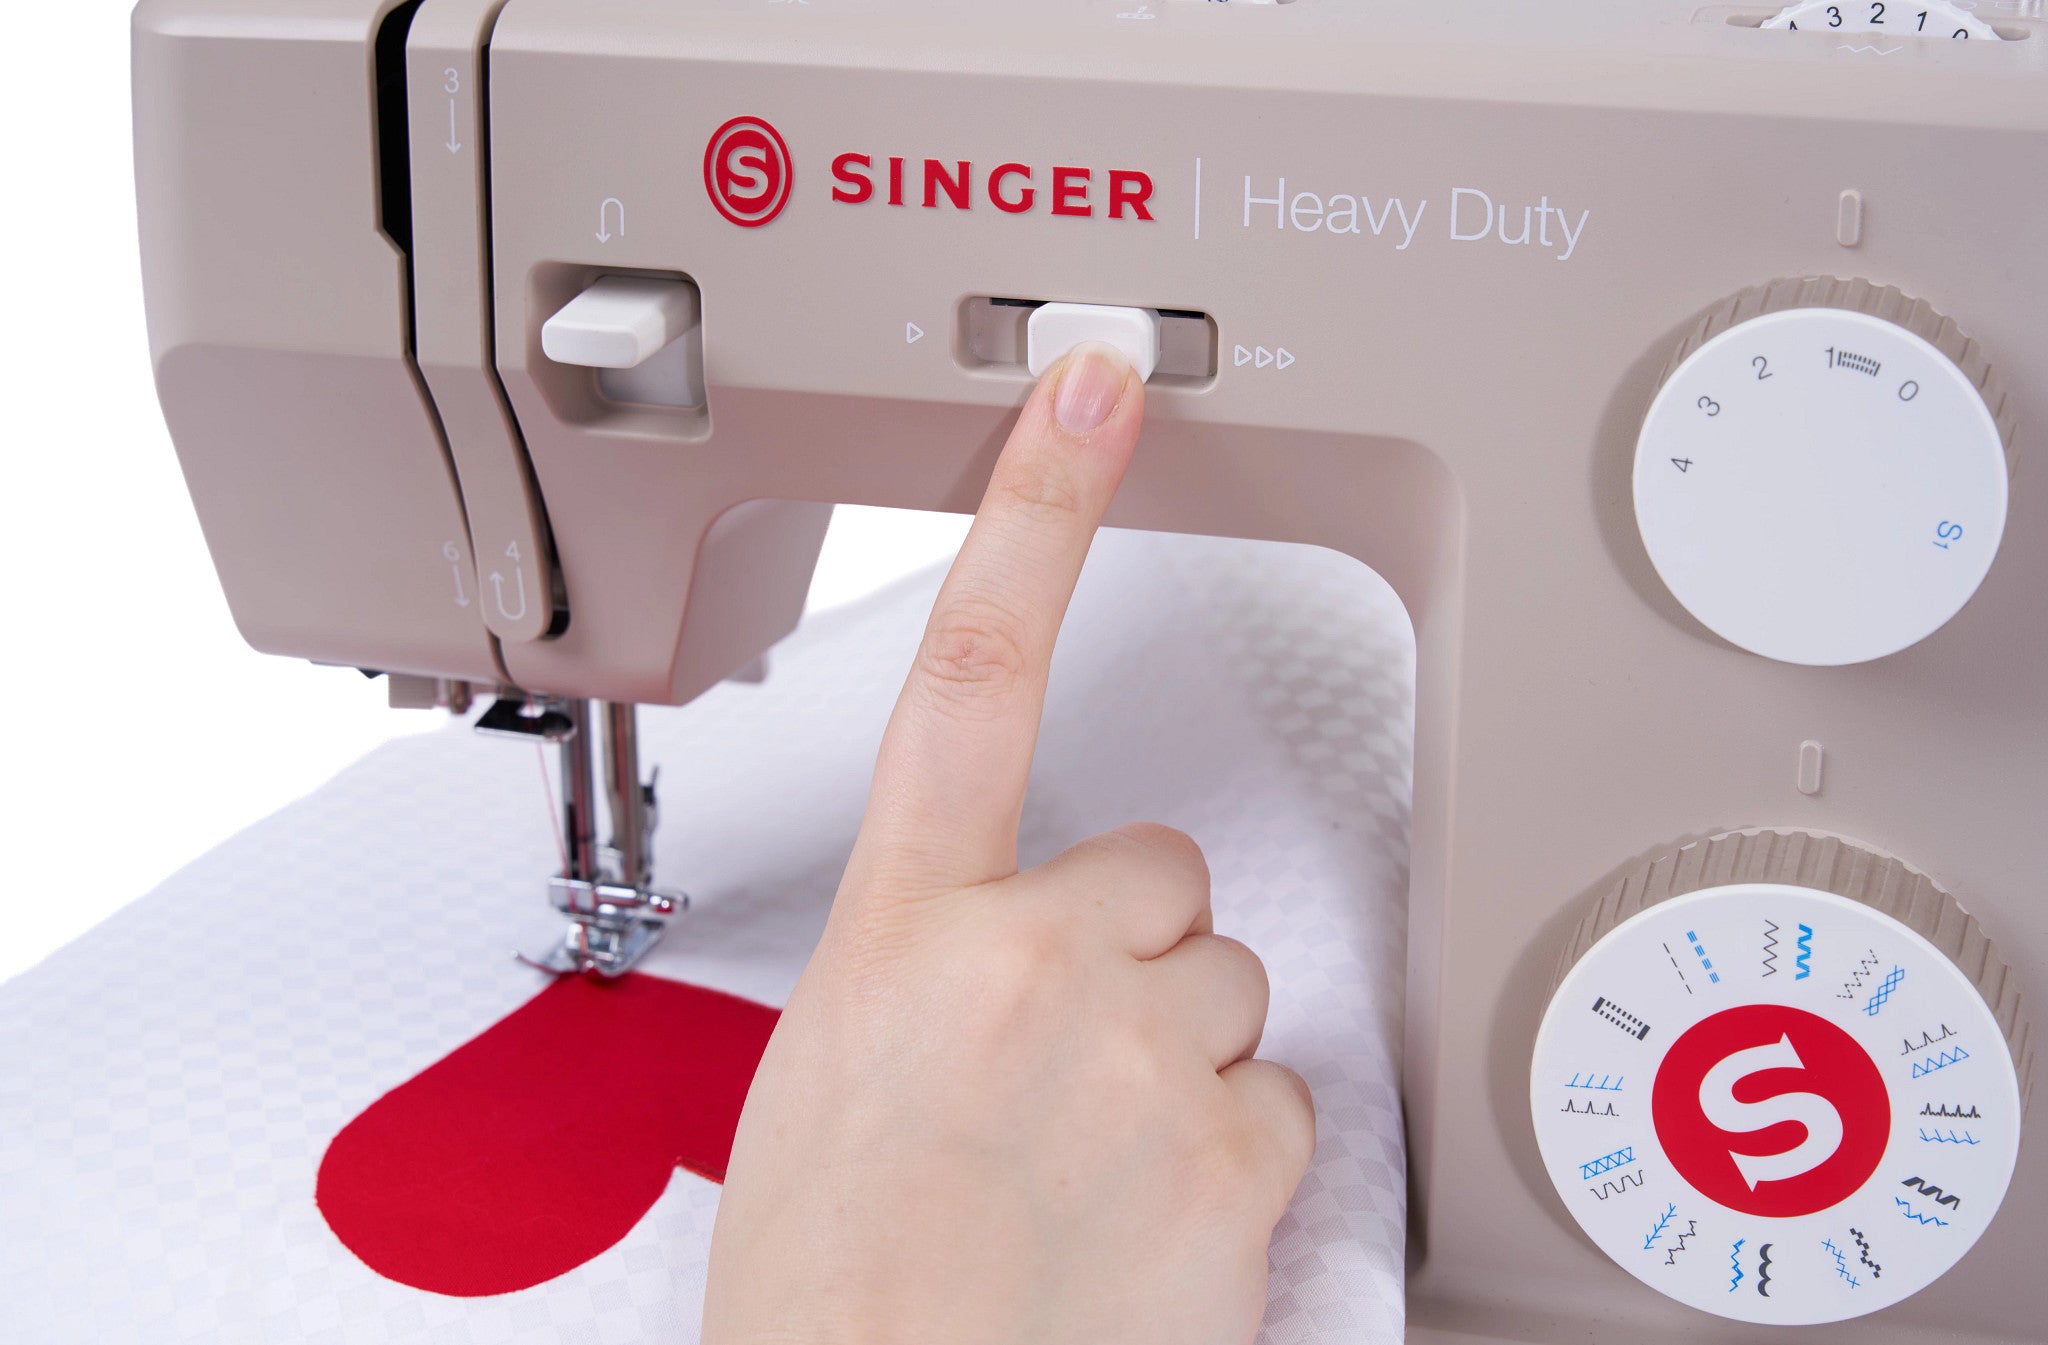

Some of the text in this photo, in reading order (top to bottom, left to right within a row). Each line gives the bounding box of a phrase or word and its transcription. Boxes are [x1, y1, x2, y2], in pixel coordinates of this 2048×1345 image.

[1826, 6, 1843, 27] 3
[1870, 2, 1885, 24] 2
[1917, 11, 1928, 31] 1
[444, 67, 460, 93] 3
[831, 152, 1590, 261] SINGER Heavy Duty
[1751, 355, 1773, 380] 2
[1824, 346, 1834, 368] 1
[1898, 380, 1919, 401] 0
[1697, 396, 1720, 416] 3
[1671, 456, 1693, 473] 4
[1933, 521, 1963, 550] S1
[442, 541, 460, 562] 6
[506, 541, 521, 561] 4
